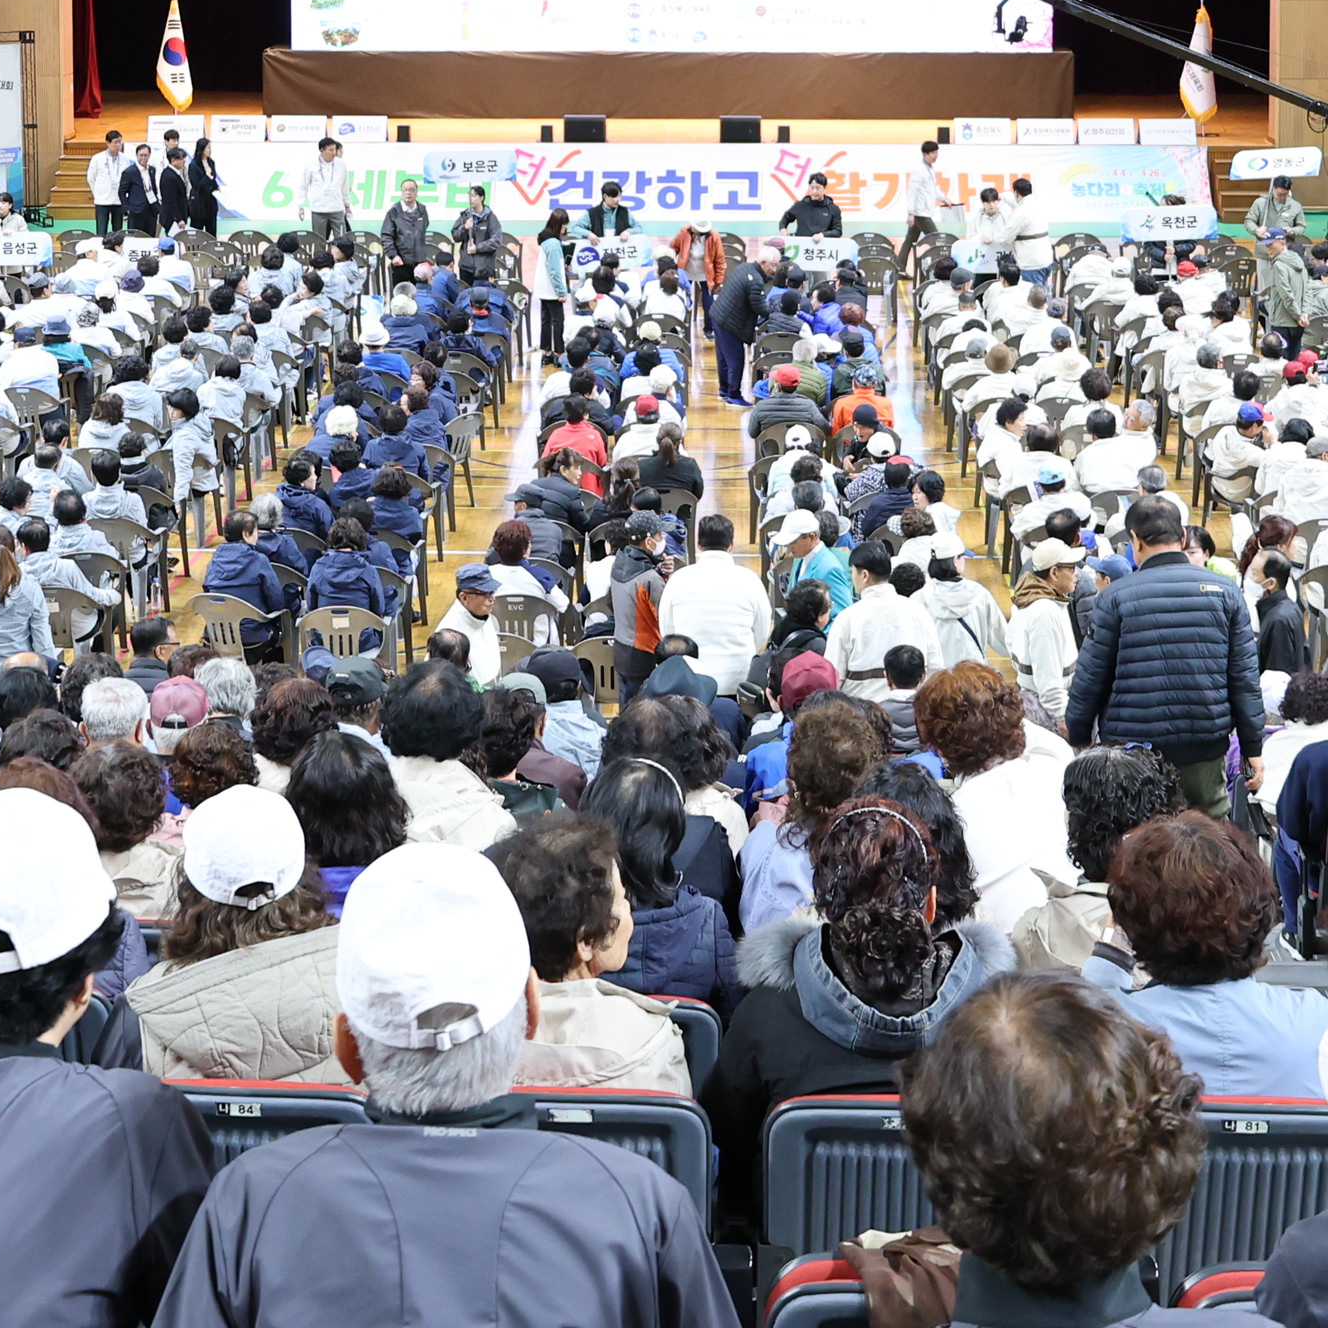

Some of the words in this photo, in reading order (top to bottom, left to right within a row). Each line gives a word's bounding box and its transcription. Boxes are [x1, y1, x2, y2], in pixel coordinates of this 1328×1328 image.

[462, 159, 498, 173] 보은군
[1273, 156, 1305, 168] 영동군
[547, 169, 762, 211] 건강하고
[773, 148, 813, 189] 더
[1071, 182, 1120, 197] 농다리
[1161, 215, 1198, 229] 옥천군
[3, 241, 38, 255] 음성군
[803, 248, 840, 261] 청주시
[128, 250, 160, 263] 증평
[218, 1103, 230, 1114] 나
[238, 1104, 254, 1114] 84
[1224, 1121, 1235, 1131] 나
[1245, 1121, 1260, 1131] 81
